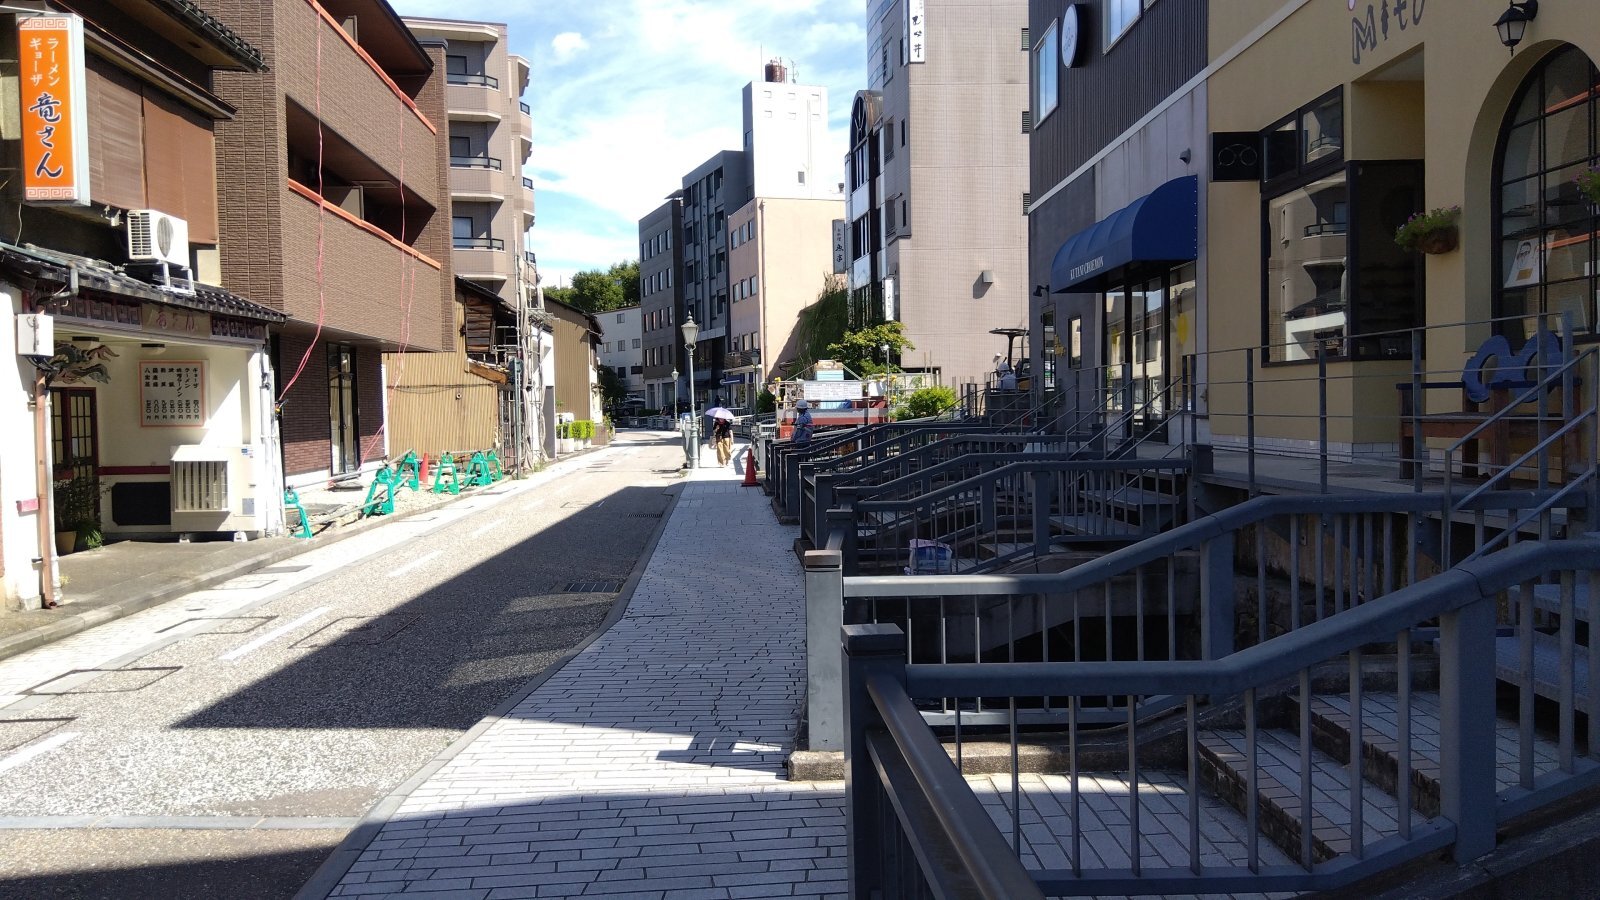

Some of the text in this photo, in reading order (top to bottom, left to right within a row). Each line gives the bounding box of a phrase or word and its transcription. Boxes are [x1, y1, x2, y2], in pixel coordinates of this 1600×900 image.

[29, 37, 42, 86] ギョーザ
[47, 38, 60, 87] ラーメン
[29, 92, 63, 178] 竜さん
